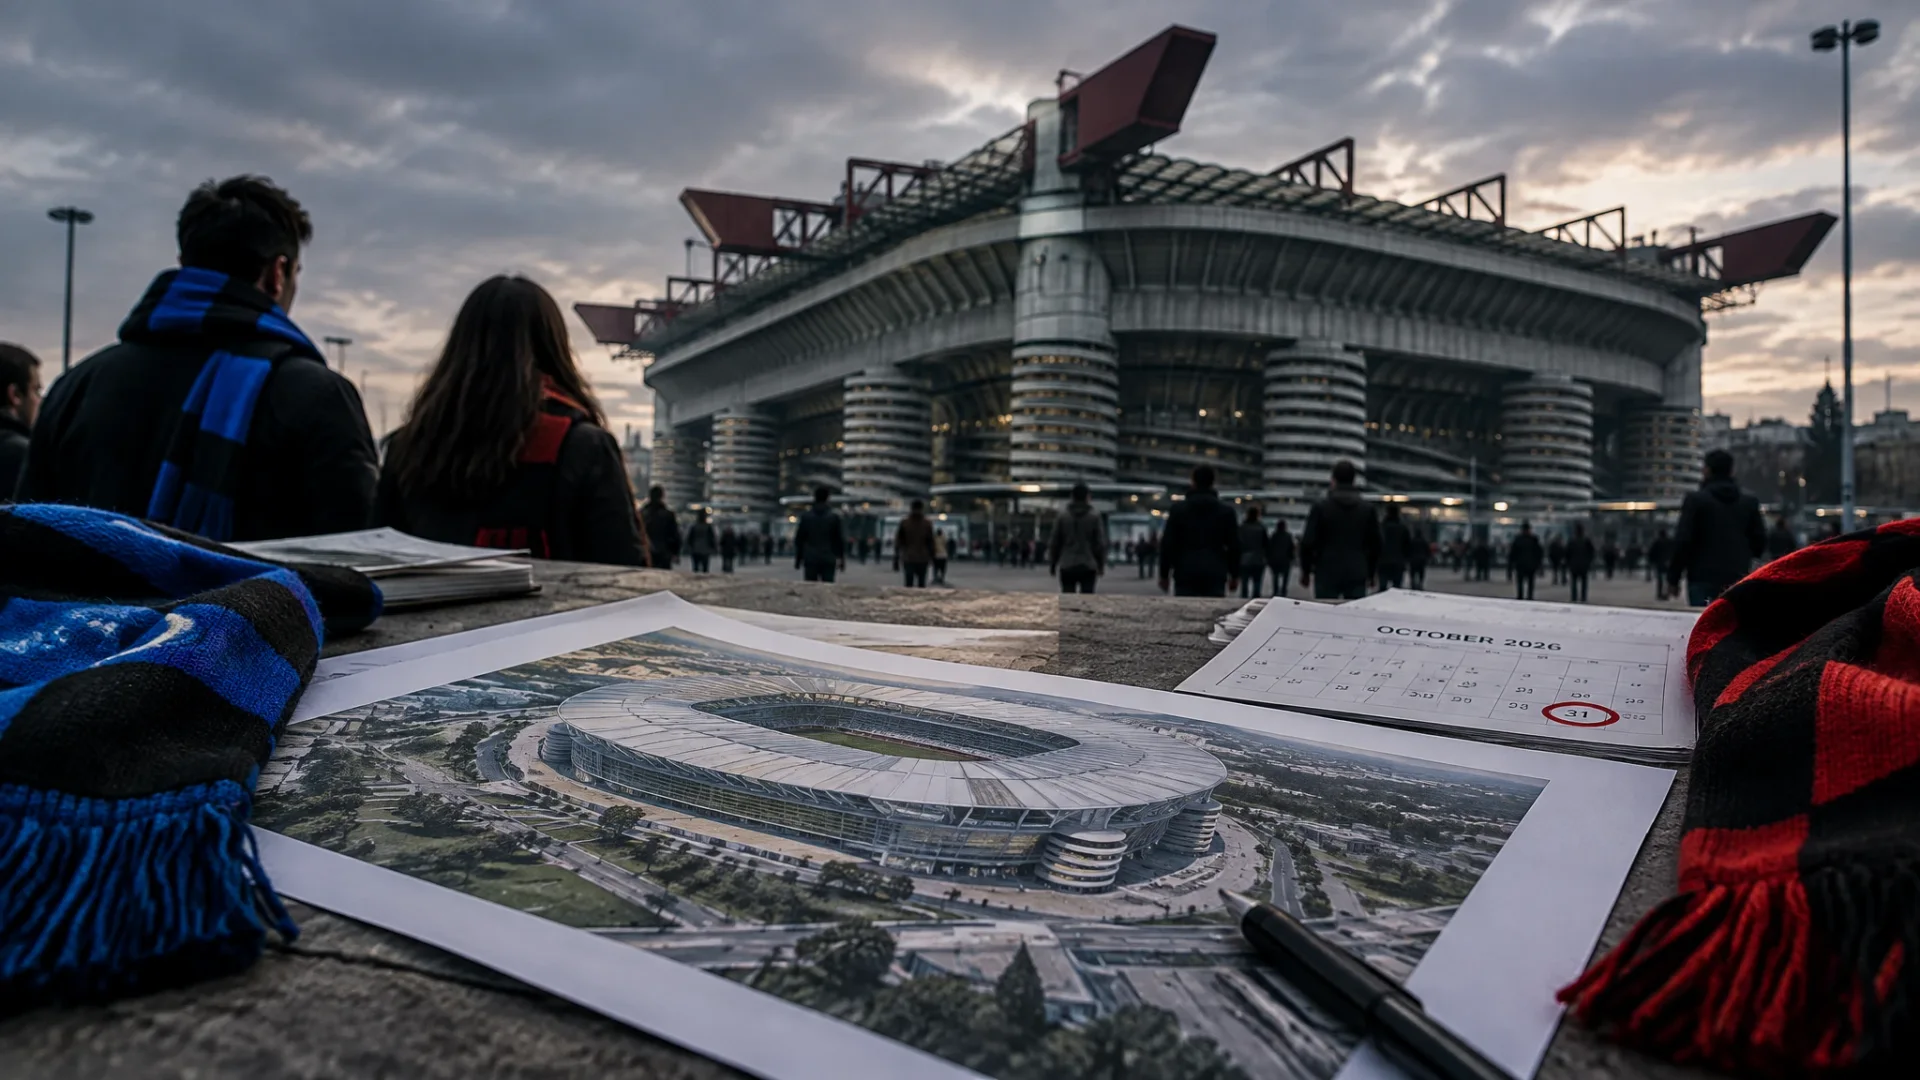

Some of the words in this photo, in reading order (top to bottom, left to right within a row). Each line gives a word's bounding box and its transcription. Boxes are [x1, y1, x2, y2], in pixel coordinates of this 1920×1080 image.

[1377, 625, 1494, 644] OCTOBER
[1504, 639, 1562, 651] 2026
[1564, 709, 1589, 719] 31
